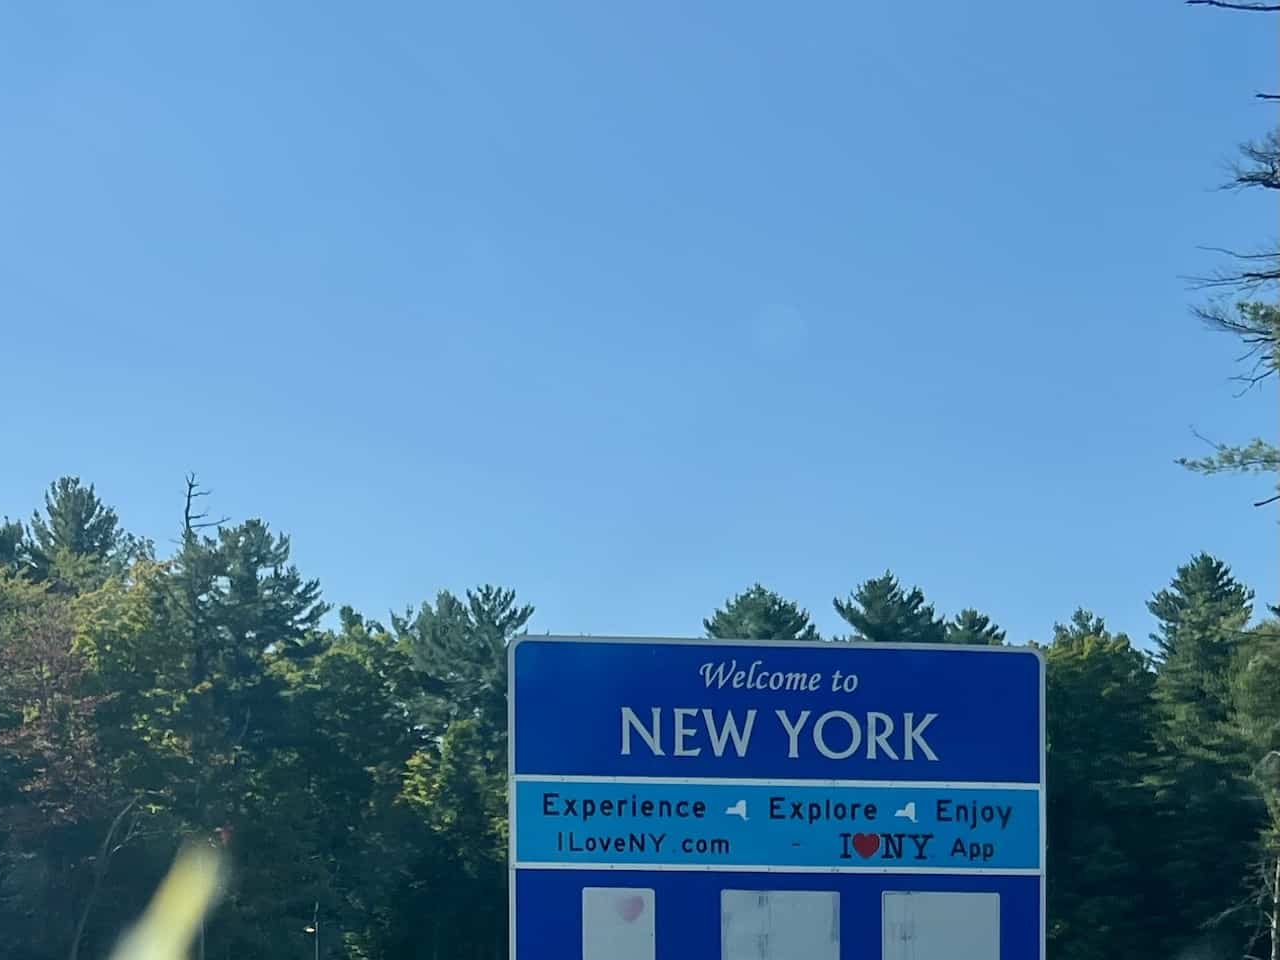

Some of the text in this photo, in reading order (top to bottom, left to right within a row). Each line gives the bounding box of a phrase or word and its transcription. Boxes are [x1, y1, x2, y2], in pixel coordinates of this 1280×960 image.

[699, 660, 859, 693] Welcome to
[620, 707, 940, 761] NEW YORK
[543, 793, 1013, 829] Experience Explore Enjoy
[951, 838, 995, 861] App
